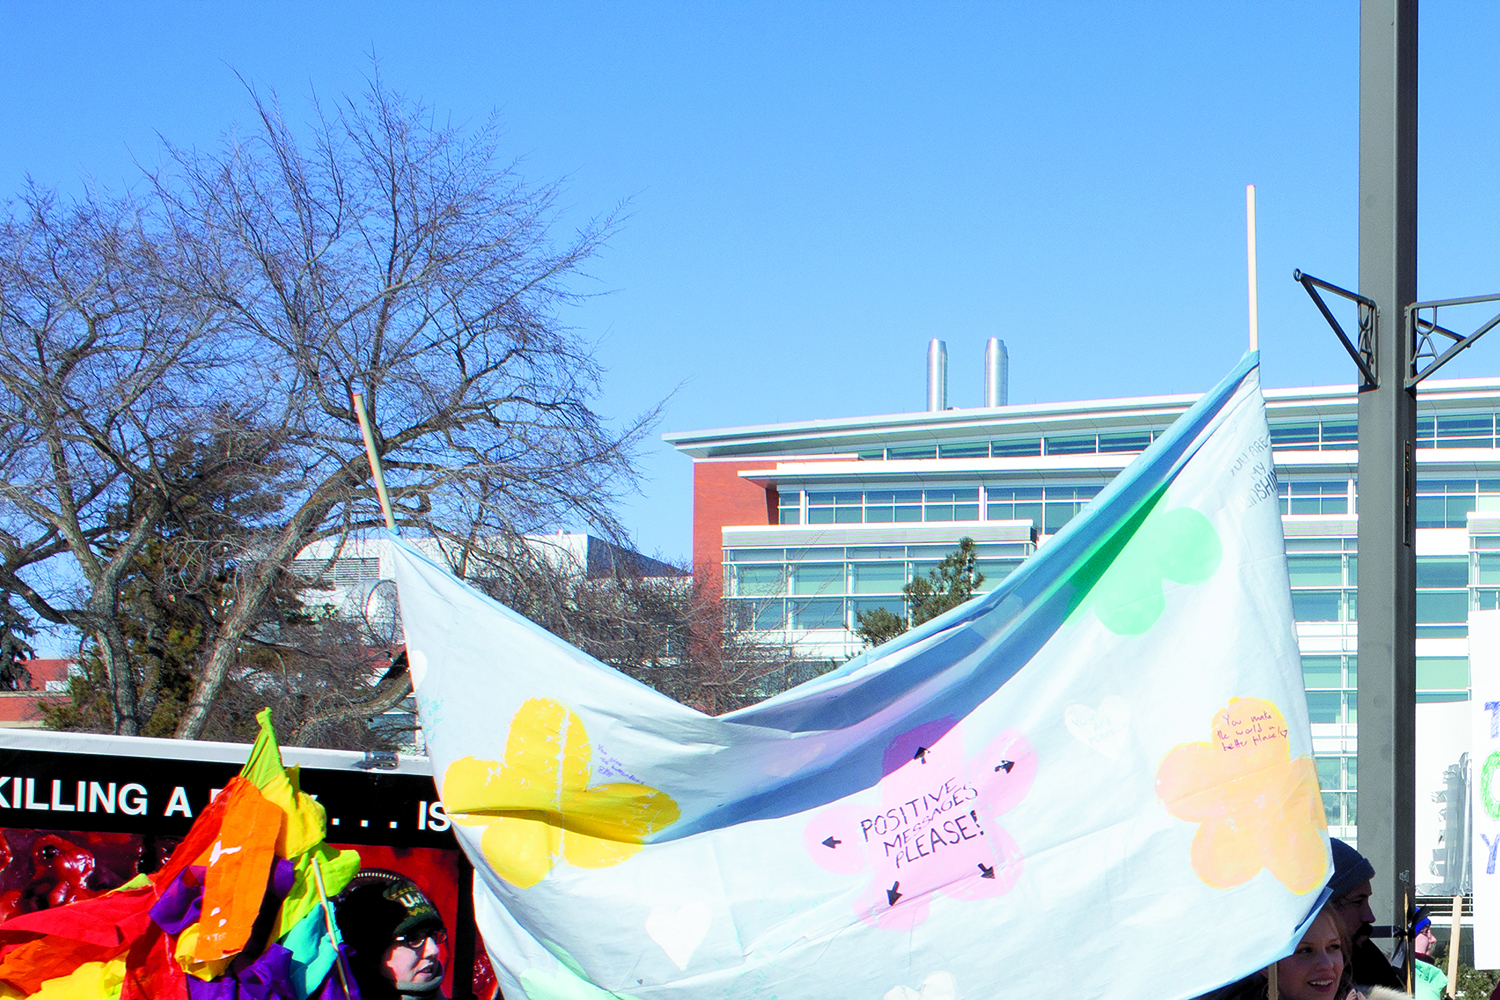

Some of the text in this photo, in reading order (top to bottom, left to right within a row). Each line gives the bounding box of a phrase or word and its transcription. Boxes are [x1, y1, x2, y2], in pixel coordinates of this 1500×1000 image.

[163, 786, 193, 818] A
[418, 800, 451, 832] IS
[860, 776, 956, 842] POSITIVE
[883, 781, 978, 857] MESSAGES
[895, 810, 985, 869] PLEASE!
